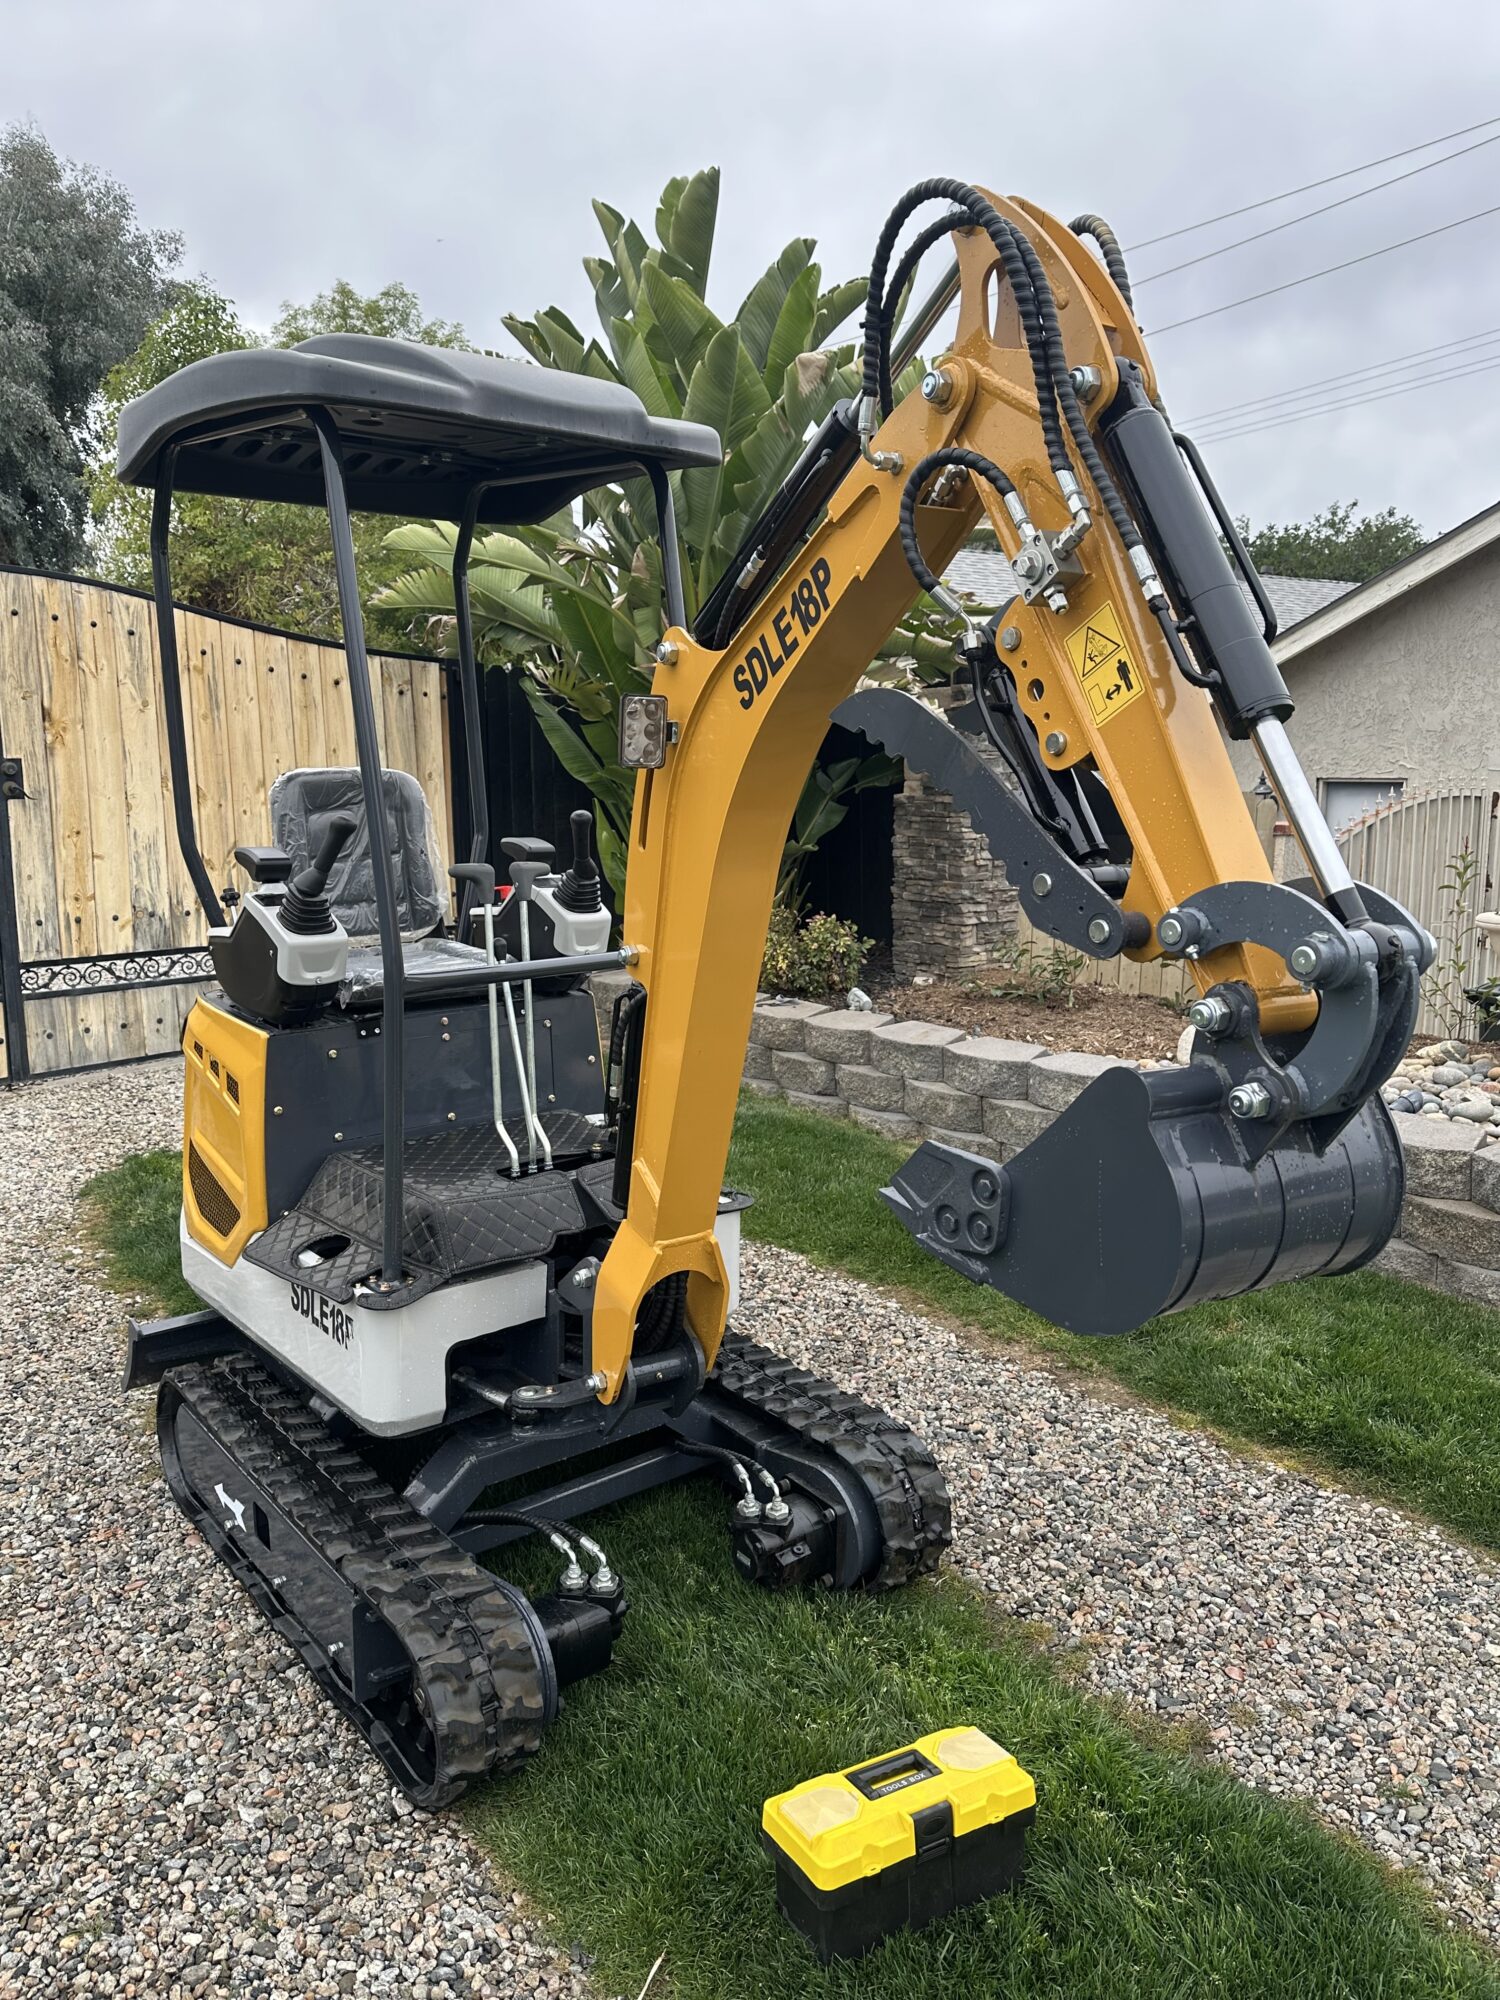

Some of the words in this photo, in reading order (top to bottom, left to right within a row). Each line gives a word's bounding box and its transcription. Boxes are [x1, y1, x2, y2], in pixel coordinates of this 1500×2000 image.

[733, 557, 831, 710] SDLE18P
[881, 1780, 908, 1793] TOOLS
[909, 1772, 926, 1783] BOX
